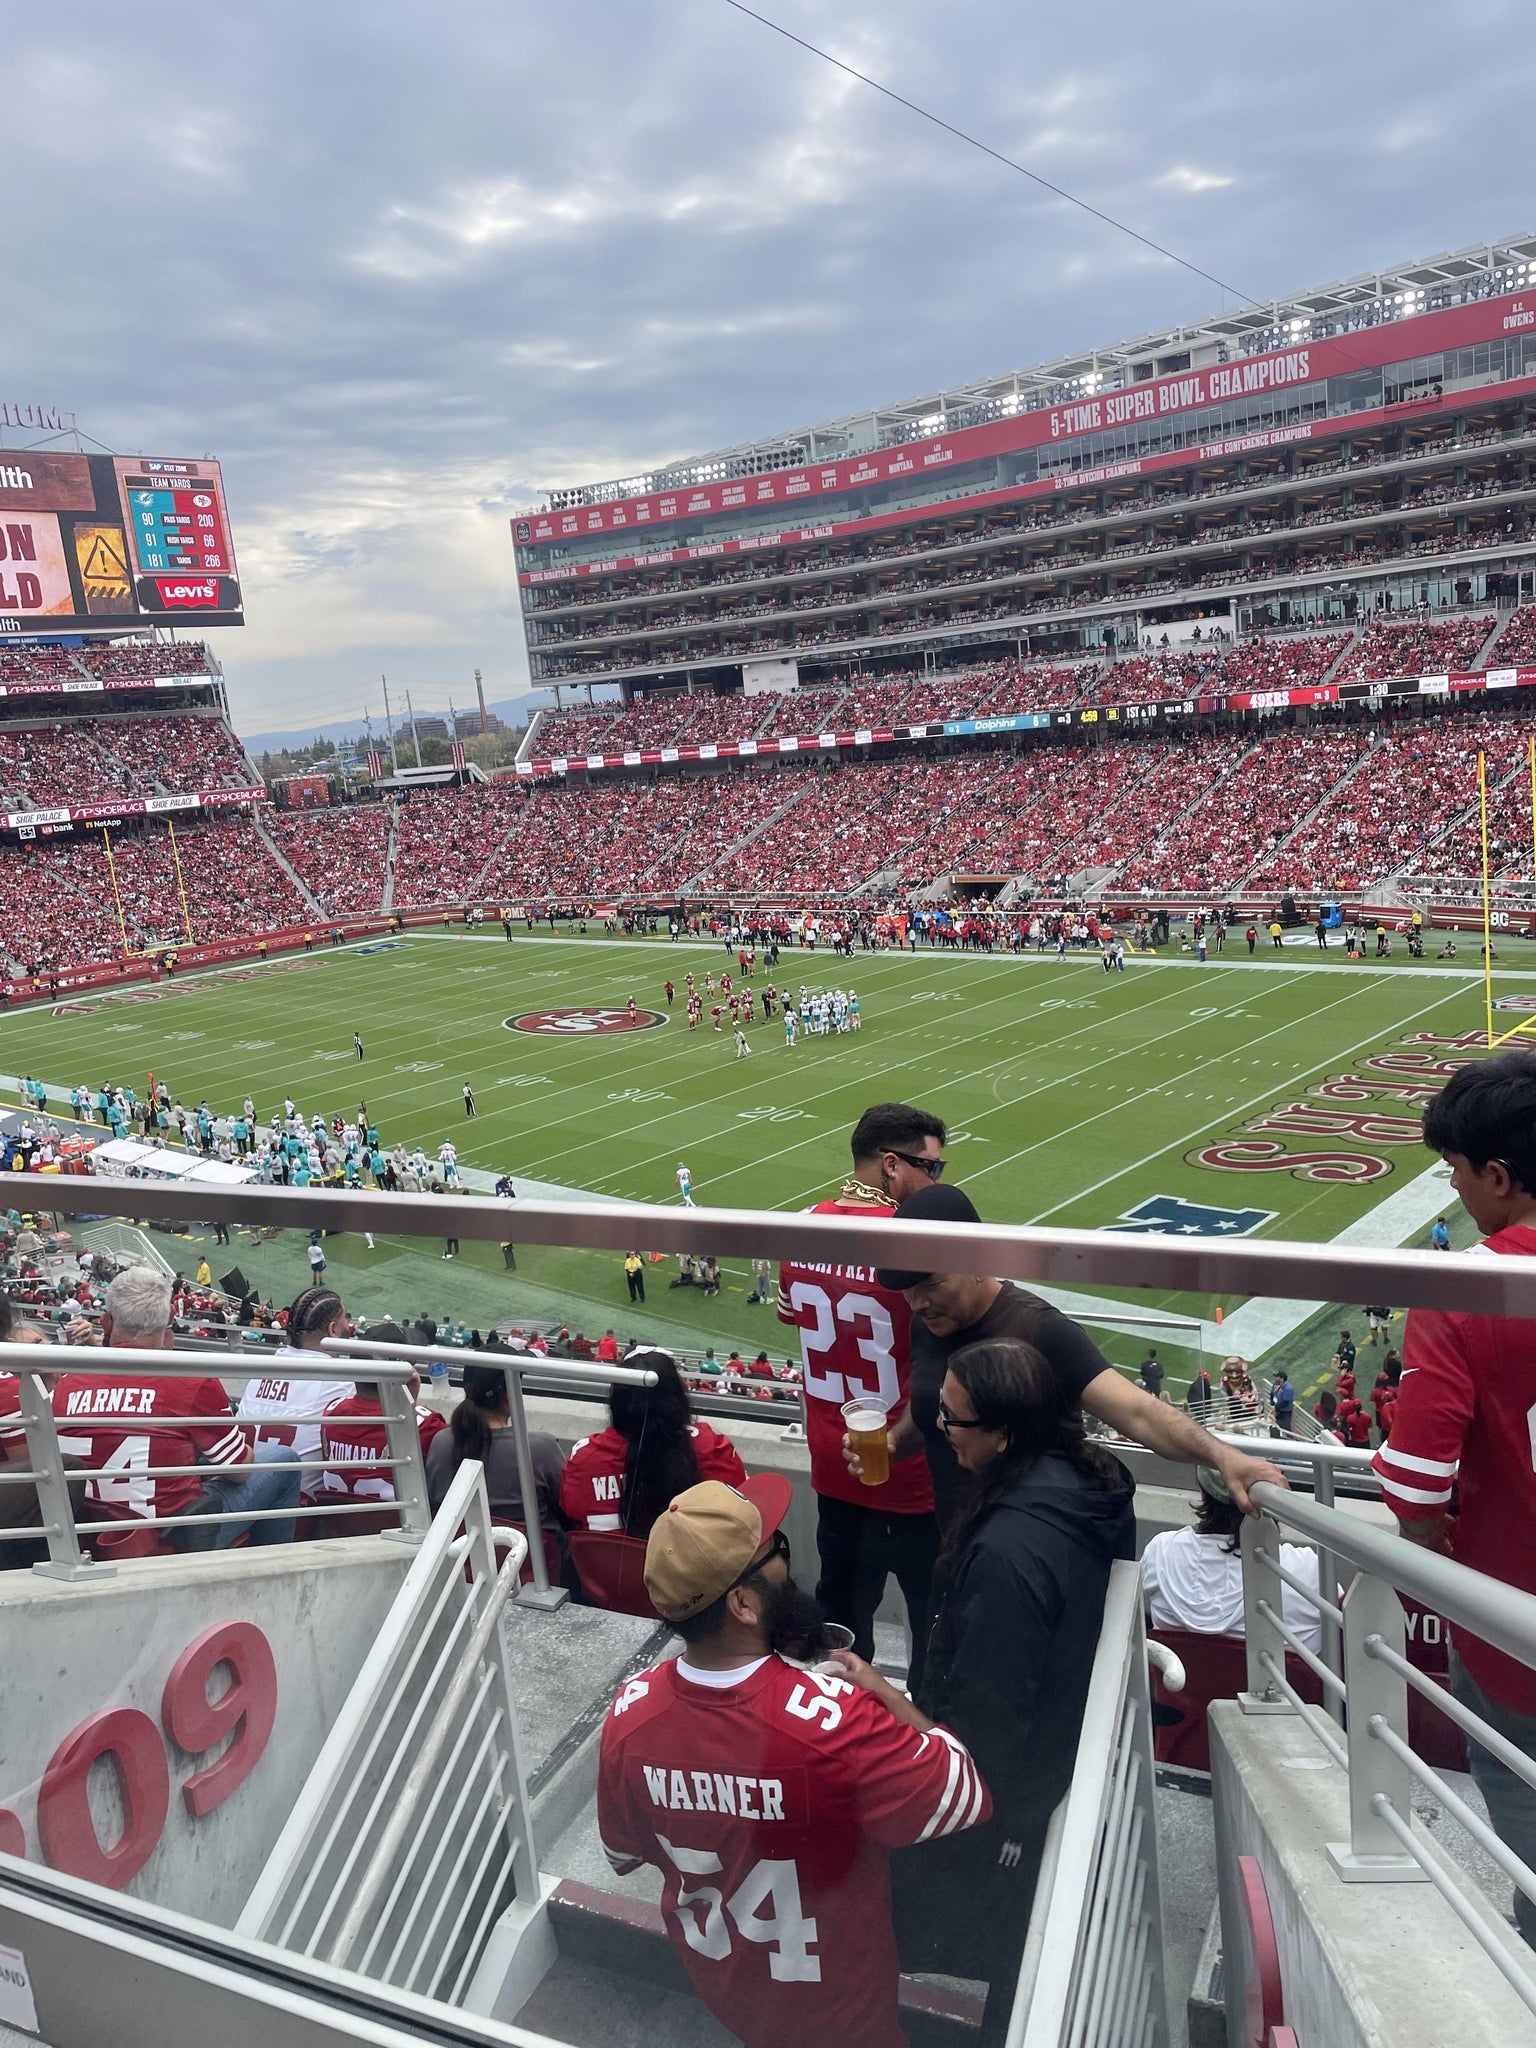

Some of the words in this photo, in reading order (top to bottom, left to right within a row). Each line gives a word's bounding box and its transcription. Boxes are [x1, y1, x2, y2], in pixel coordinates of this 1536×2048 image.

[1503, 311, 1535, 330] OWENS
[1051, 401, 1102, 437] 5-TIME
[1106, 389, 1155, 424] SUPER
[1158, 377, 1205, 412] BOWL
[1209, 350, 1310, 399] CHAMPIONS
[1224, 433, 1269, 455] CONFERENCE
[1270, 425, 1312, 445] CHAMPIONS
[1079, 469, 1105, 485] DIVISION
[1105, 462, 1142, 480] CHAMPIONS
[150, 478, 168, 488] TEAM
[170, 479, 191, 489] YARDS
[822, 477, 837, 489] LOTT
[722, 494, 746, 506] JOHNSON
[757, 488, 775, 500] JONES
[688, 500, 711, 512] JOHNSON
[142, 512, 154, 526] 90
[197, 514, 214, 528] 200
[145, 533, 157, 547] 91
[801, 529, 813, 540] BILL
[814, 526, 833, 538] WALSH
[203, 534, 215, 548] 66
[147, 554, 163, 567] 181
[204, 554, 221, 568] 266
[66, 683, 80, 691] SHOE
[80, 682, 99, 690] PALACE
[1369, 683, 1388, 696] 1:30
[1249, 690, 1290, 709] 49ERS
[1324, 689, 1330, 700] 3
[1066, 712, 1071, 724] 3
[1080, 710, 1098, 722] 4:59
[1126, 706, 1140, 719] 1ST
[1147, 704, 1157, 717] 18
[1183, 701, 1194, 714] 36
[974, 718, 1016, 731] Dolphins
[1032, 715, 1039, 727] 6
[221, 789, 266, 802] SHOEPALACE
[94, 802, 145, 816] SHOEPALACE
[151, 800, 169, 810] SHOE
[169, 797, 194, 808] PALACE
[16, 814, 34, 824] SHOE
[36, 811, 63, 822] PALACE
[93, 819, 122, 828] NetApp
[53, 823, 74, 832] bank
[607, 1087, 666, 1103] 30
[736, 1105, 805, 1122] 20
[790, 1281, 901, 1412] 23
[255, 1378, 290, 1402] BOSA
[66, 1388, 156, 1415] WARNER
[785, 1670, 855, 1732] 54
[642, 1764, 786, 1821] WARNER
[654, 1832, 822, 1982] 54
